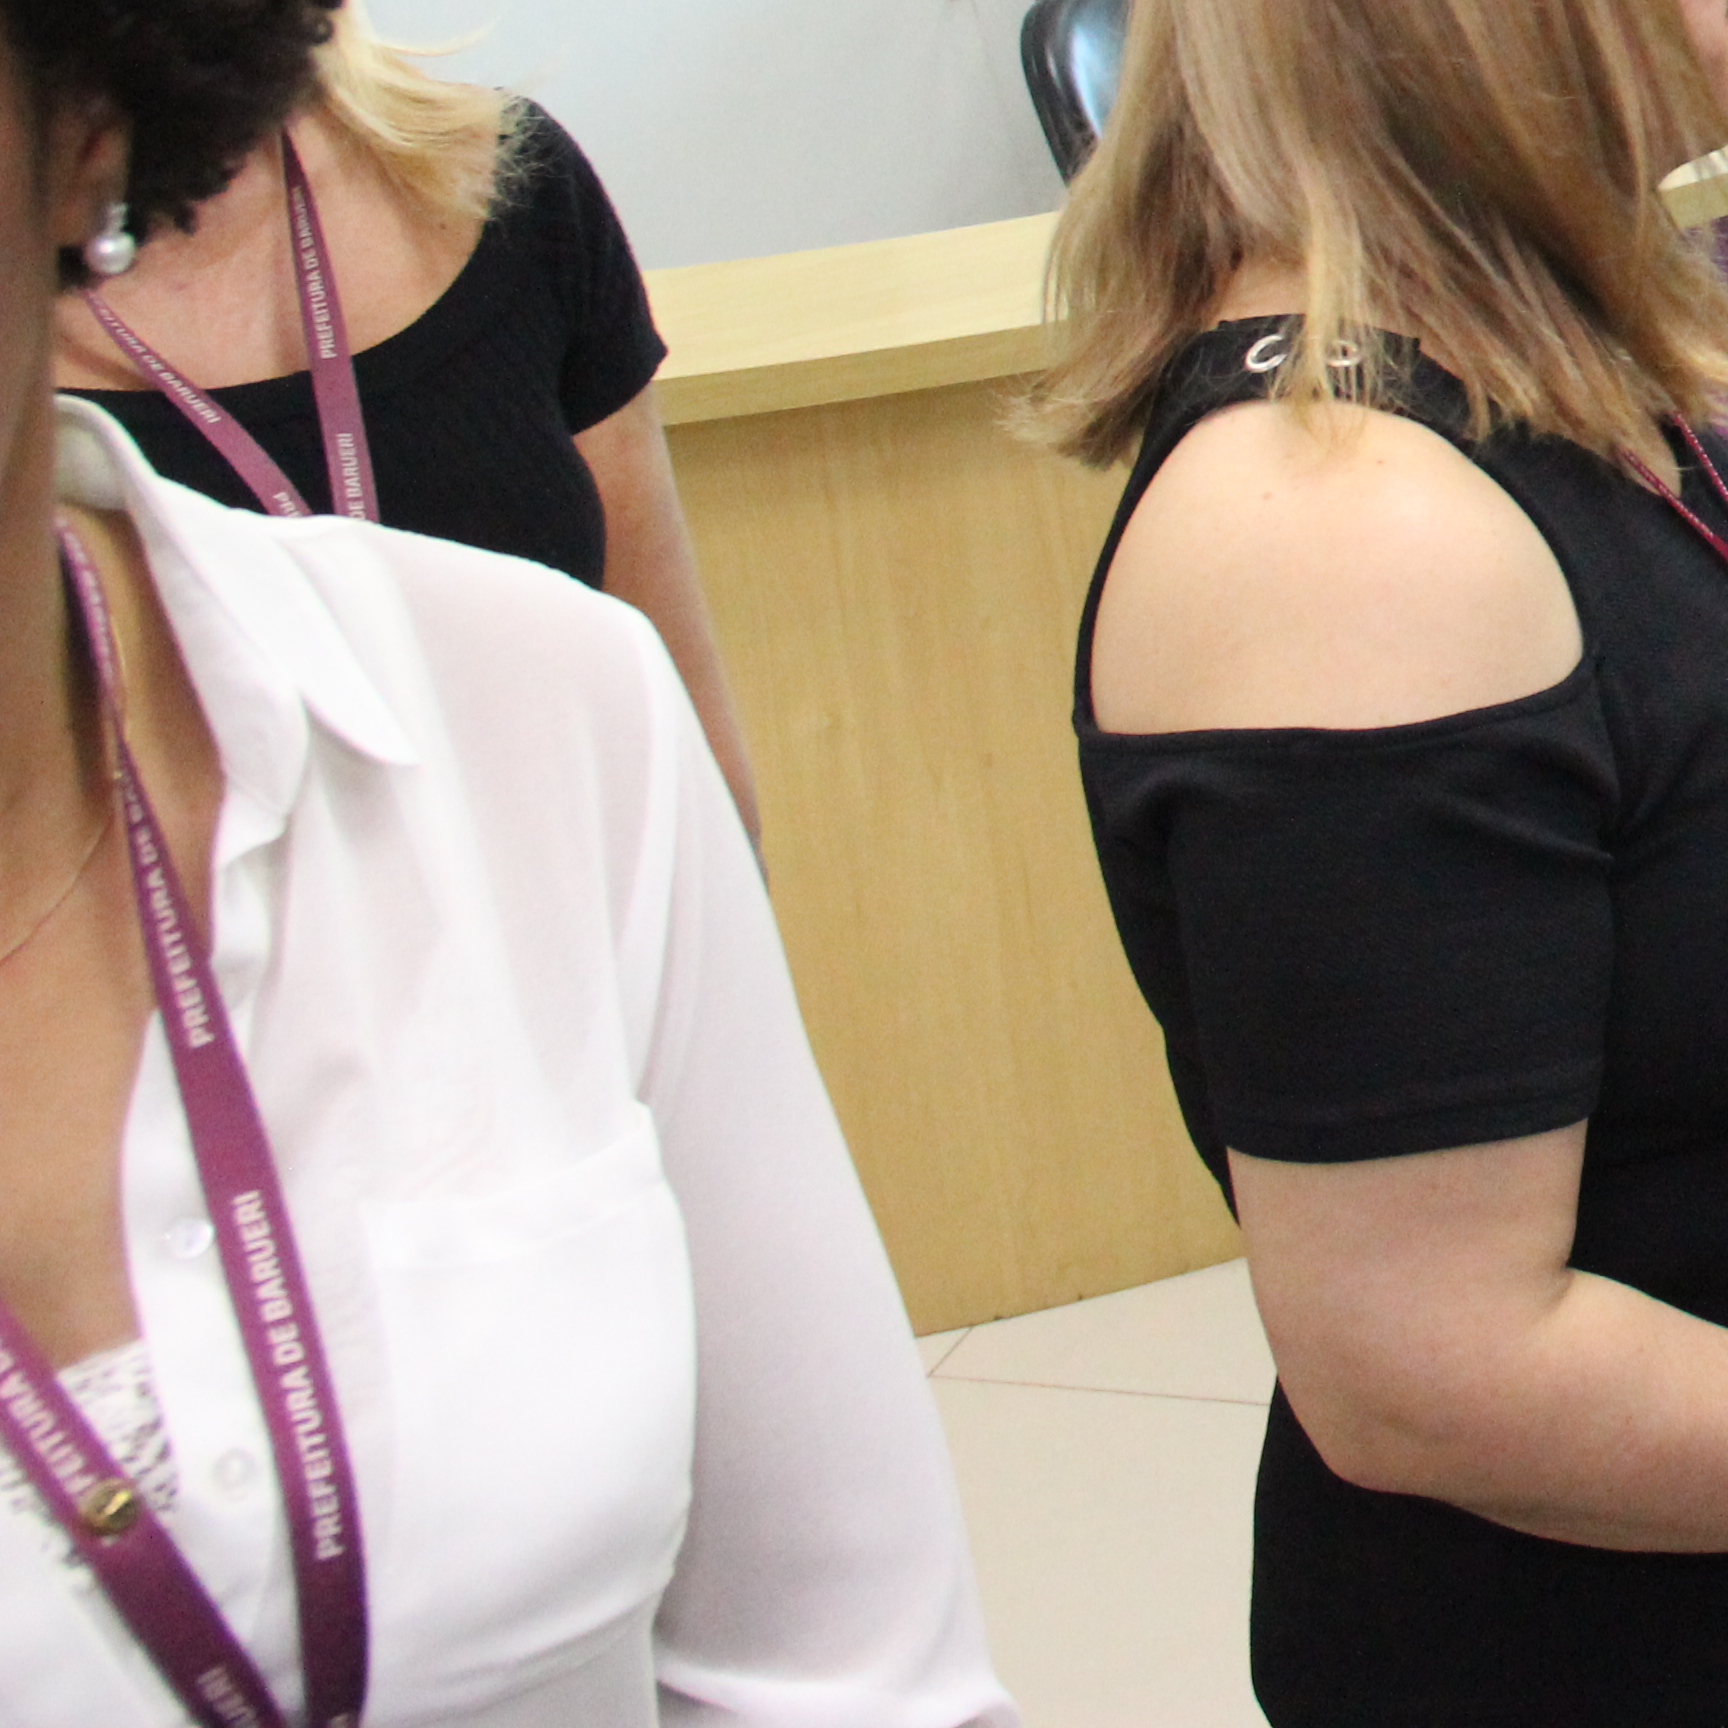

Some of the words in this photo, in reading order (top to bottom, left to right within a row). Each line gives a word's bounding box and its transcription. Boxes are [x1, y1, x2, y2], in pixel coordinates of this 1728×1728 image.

[301, 247, 320, 271] DE
[305, 269, 338, 359] PREFEITURA
[142, 354, 165, 372] DE
[158, 372, 222, 424] BARUERI
[337, 432, 364, 499] BARUERI
[135, 825, 159, 866] DE
[147, 866, 216, 1049] PREFEITURA
[232, 1189, 296, 1324] BARUERI
[273, 1323, 309, 1369] DE
[279, 1366, 346, 1562] PREFEITURA
